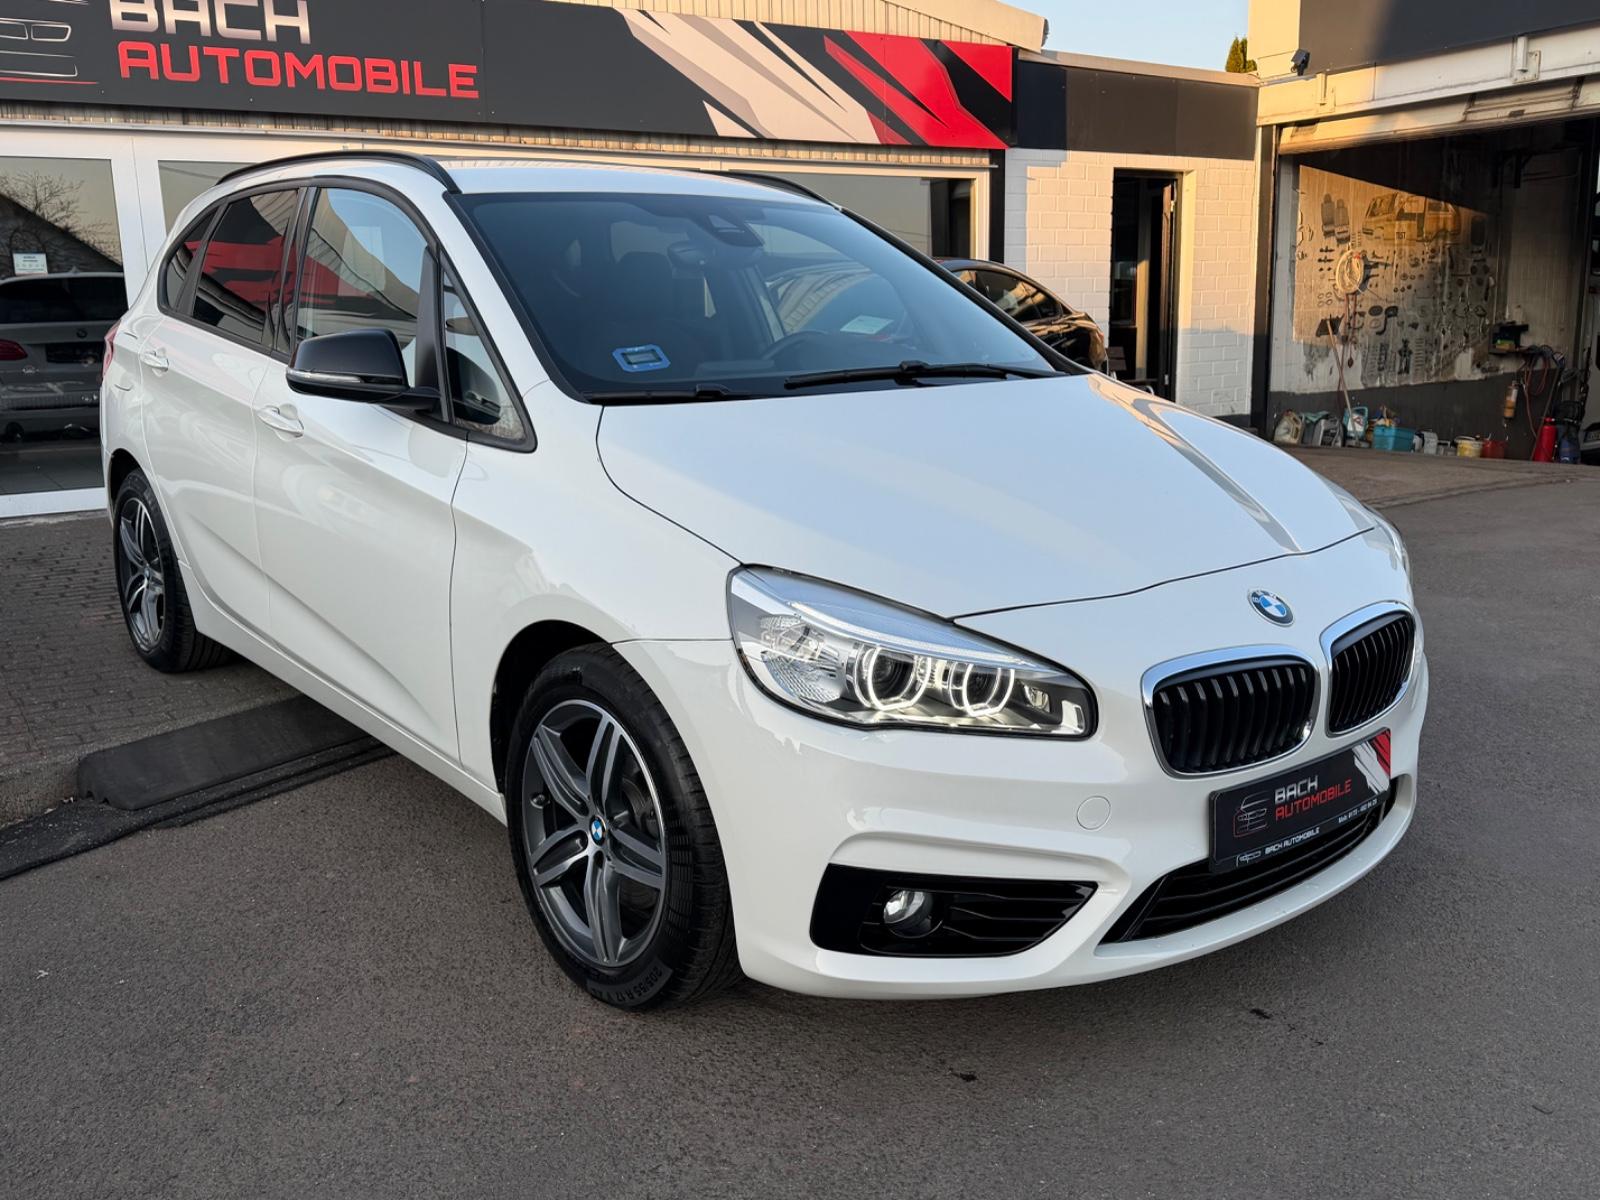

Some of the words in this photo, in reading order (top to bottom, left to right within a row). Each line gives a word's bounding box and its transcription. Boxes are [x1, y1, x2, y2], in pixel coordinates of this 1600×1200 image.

[109, 0, 311, 44] BACH
[117, 40, 479, 99] AUTOMOBILE
[1274, 775, 1319, 804] BACH
[1275, 779, 1352, 821] AUTOMOBILE
[1264, 842, 1283, 855] BACH
[1283, 827, 1320, 848] AUTOMOBILE
